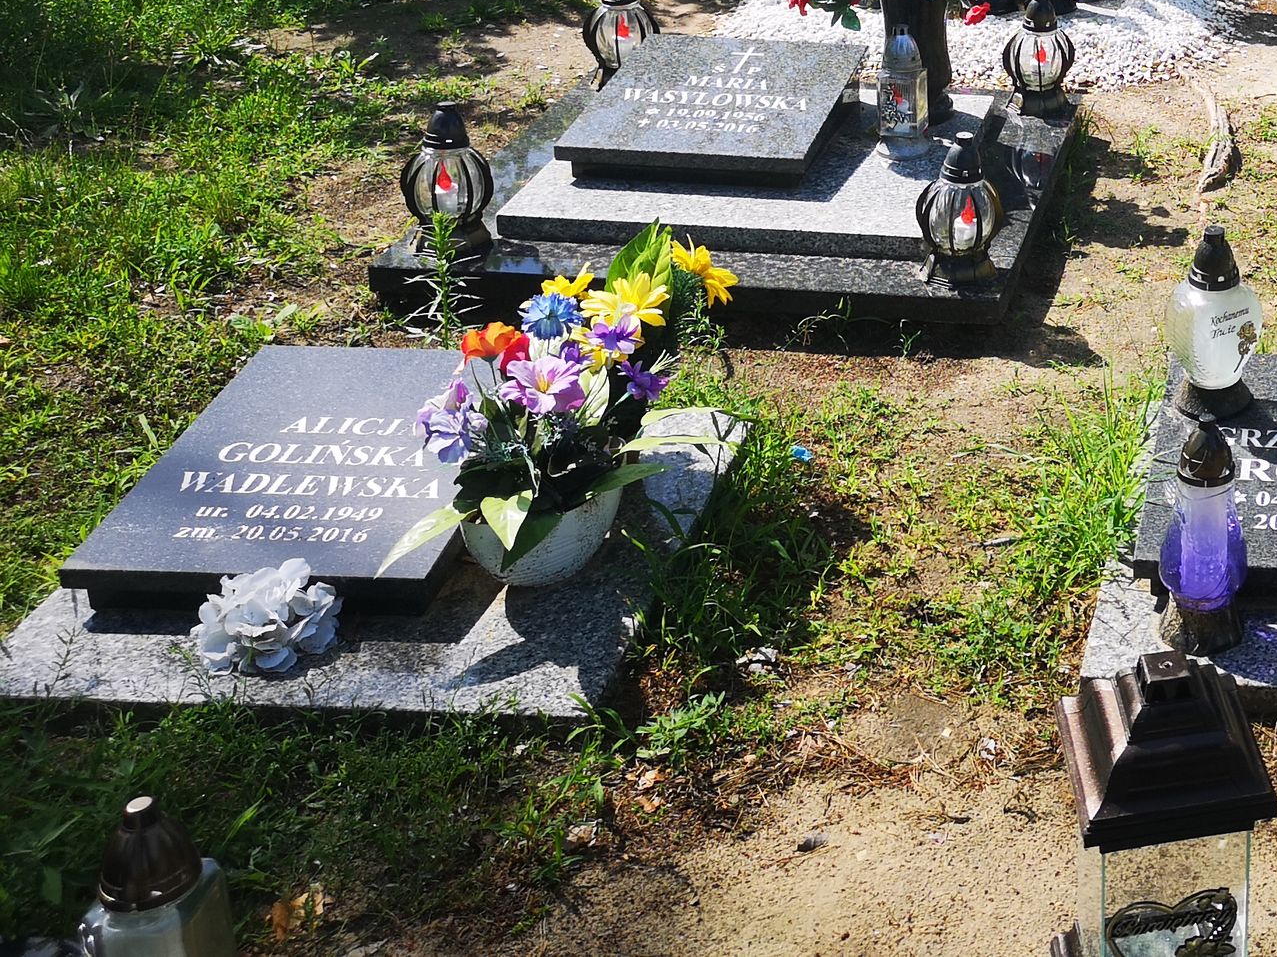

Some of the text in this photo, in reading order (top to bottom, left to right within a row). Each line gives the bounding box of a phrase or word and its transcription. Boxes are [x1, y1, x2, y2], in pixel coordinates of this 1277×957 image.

[747, 66, 762, 75] P
[683, 75, 768, 91] MARIA
[623, 88, 807, 111] WASYŁOWSKA
[666, 108, 766, 122] 19.09.1956
[656, 119, 760, 134] 03.05.2016
[1210, 306, 1250, 326] Kochanemu
[179, 471, 441, 499] WADLEWSKA
[195, 504, 384, 521] ur. 04.02.1949
[173, 525, 371, 543] zm. 20.05.2016
